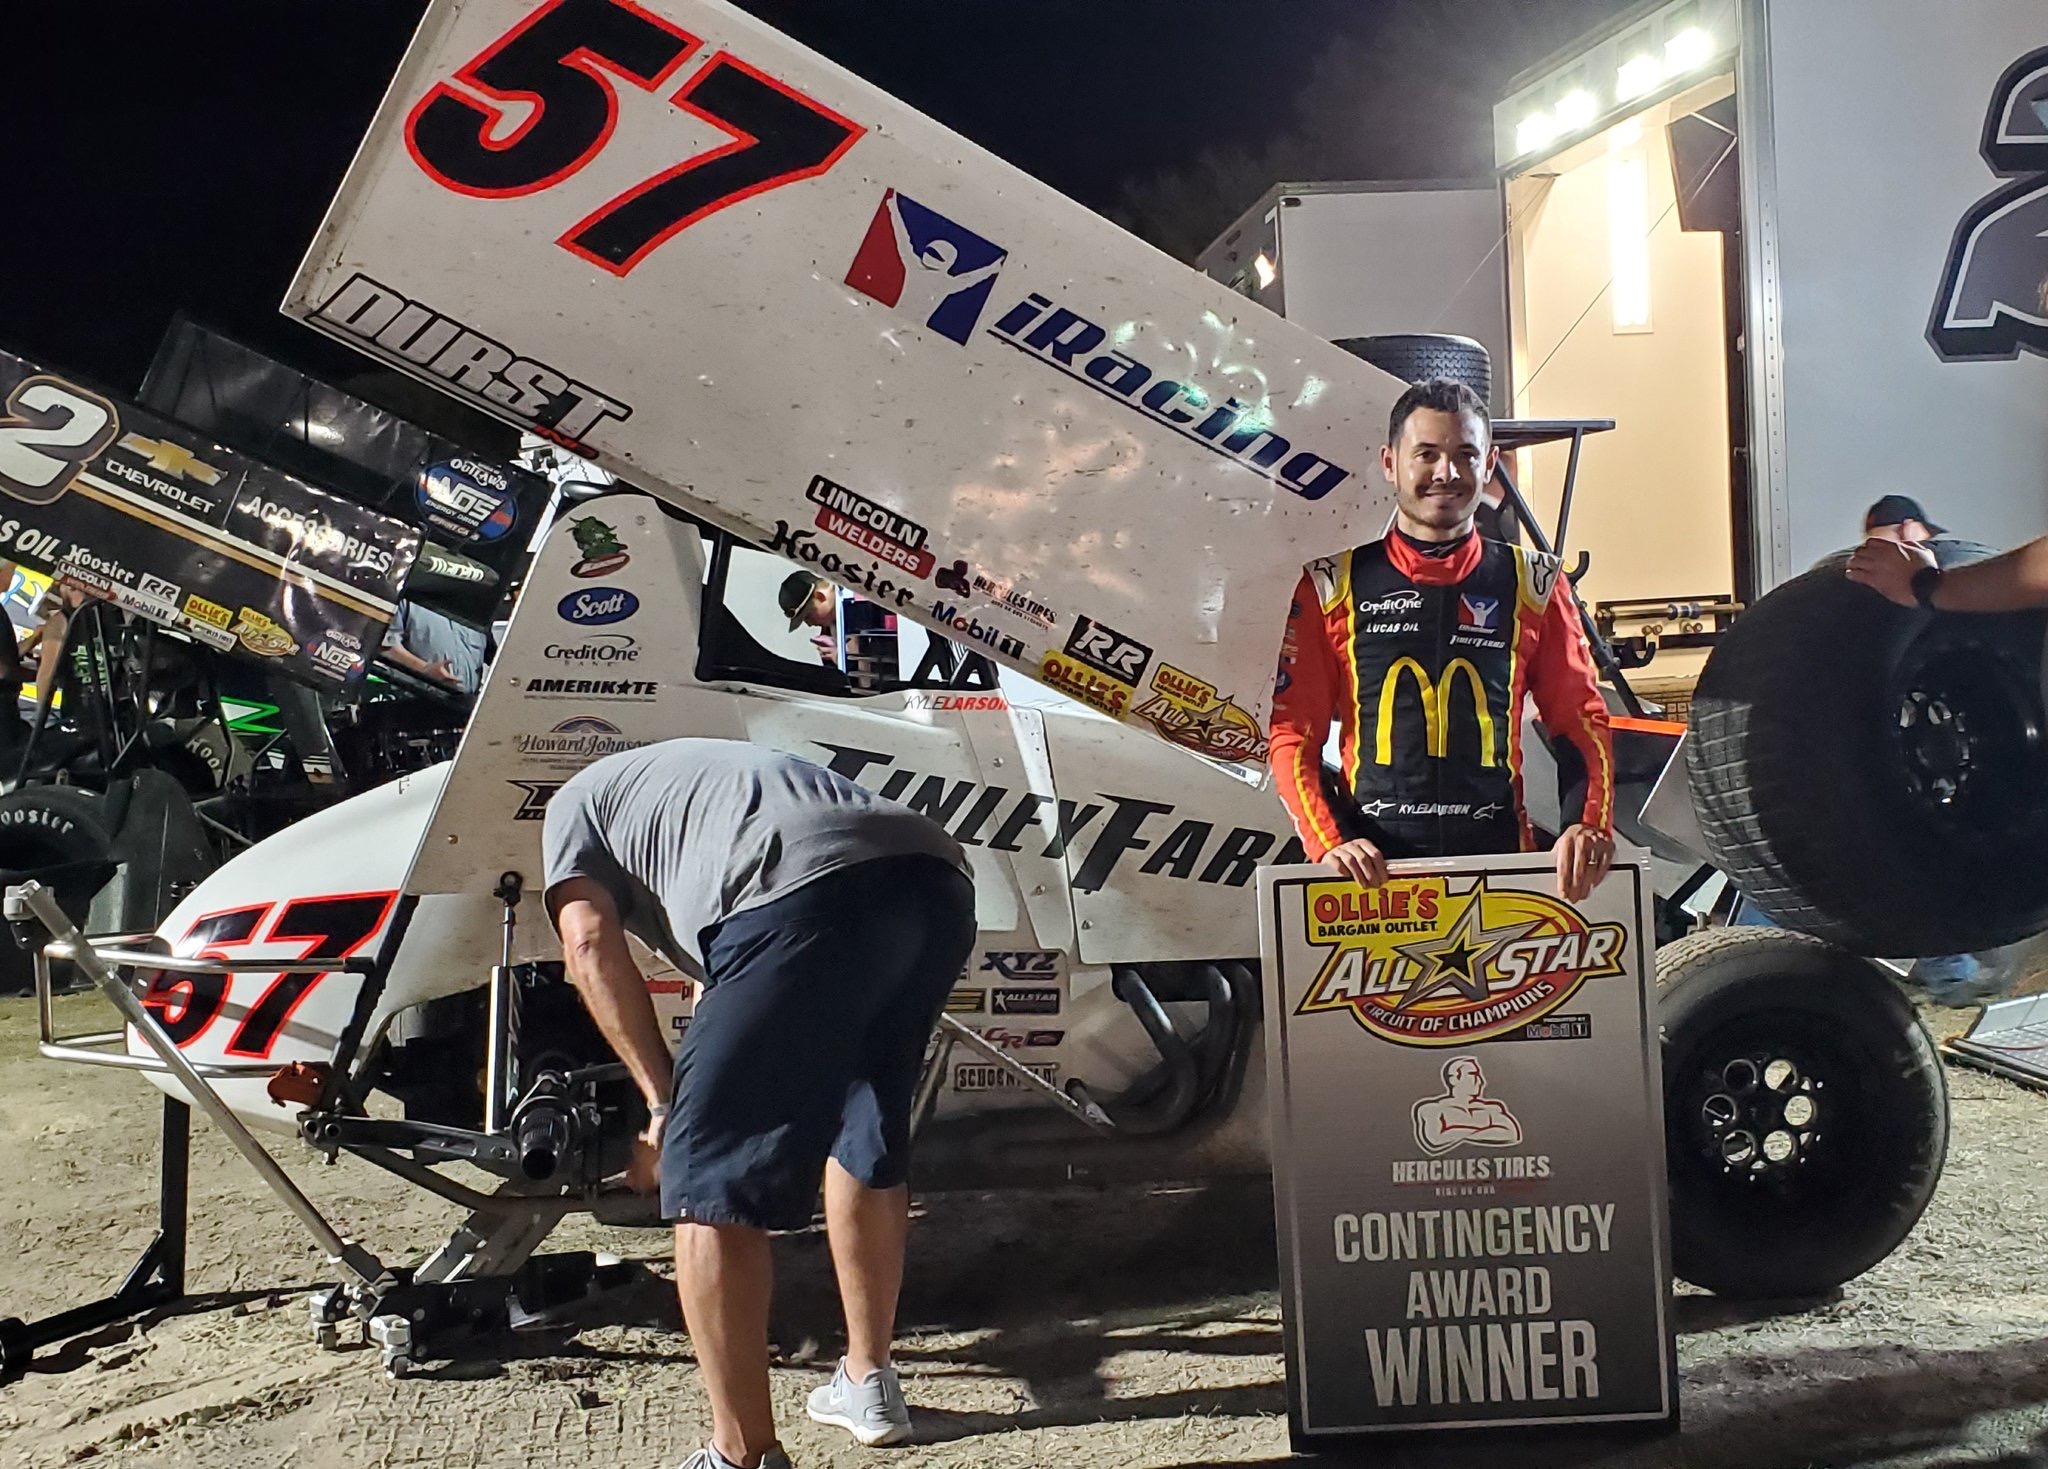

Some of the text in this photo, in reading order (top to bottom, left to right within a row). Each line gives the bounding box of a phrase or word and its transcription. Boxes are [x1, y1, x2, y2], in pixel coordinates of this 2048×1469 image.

[404, 0, 868, 278] 57
[303, 272, 633, 442] DURST
[995, 292, 1370, 500] iRacing
[0, 377, 119, 505] 2
[105, 459, 216, 514] CHEVROLET
[812, 480, 921, 548] LINCOLN
[15, 528, 61, 564] OIL
[757, 519, 915, 608] Hoosier
[828, 513, 920, 571] WELDERS
[60, 562, 111, 591] LINCOLN
[62, 544, 136, 585] Hoosier
[123, 593, 156, 616] Mobil
[143, 578, 177, 601] RR
[572, 593, 625, 619] Scott
[1359, 597, 1424, 613] CreditOne
[930, 600, 1000, 648] Mobil
[1366, 622, 1419, 633] LUCAS OIL
[314, 641, 362, 670] NOS
[543, 643, 640, 662] CreditOne
[1074, 624, 1145, 677] RR
[1146, 697, 1188, 727] ALL
[518, 734, 585, 753] Howard
[1210, 728, 1269, 758] STAR
[1314, 884, 1439, 924] OLLIE'S
[1317, 921, 1438, 937] BARGAIN OUTLET
[138, 889, 400, 1060] 57
[1317, 946, 1412, 1001] ALL
[1492, 928, 1617, 990] STAR
[1363, 979, 1556, 1032] CIRCUIT OF CHAMPIONS
[1526, 1023, 1571, 1039] Mobil
[1391, 1154, 1551, 1183] HERCULES TIRES
[1333, 1202, 1617, 1264] CONTINGENCY
[1405, 1266, 1553, 1321] AWARD
[1364, 1319, 1600, 1408] WINNER
